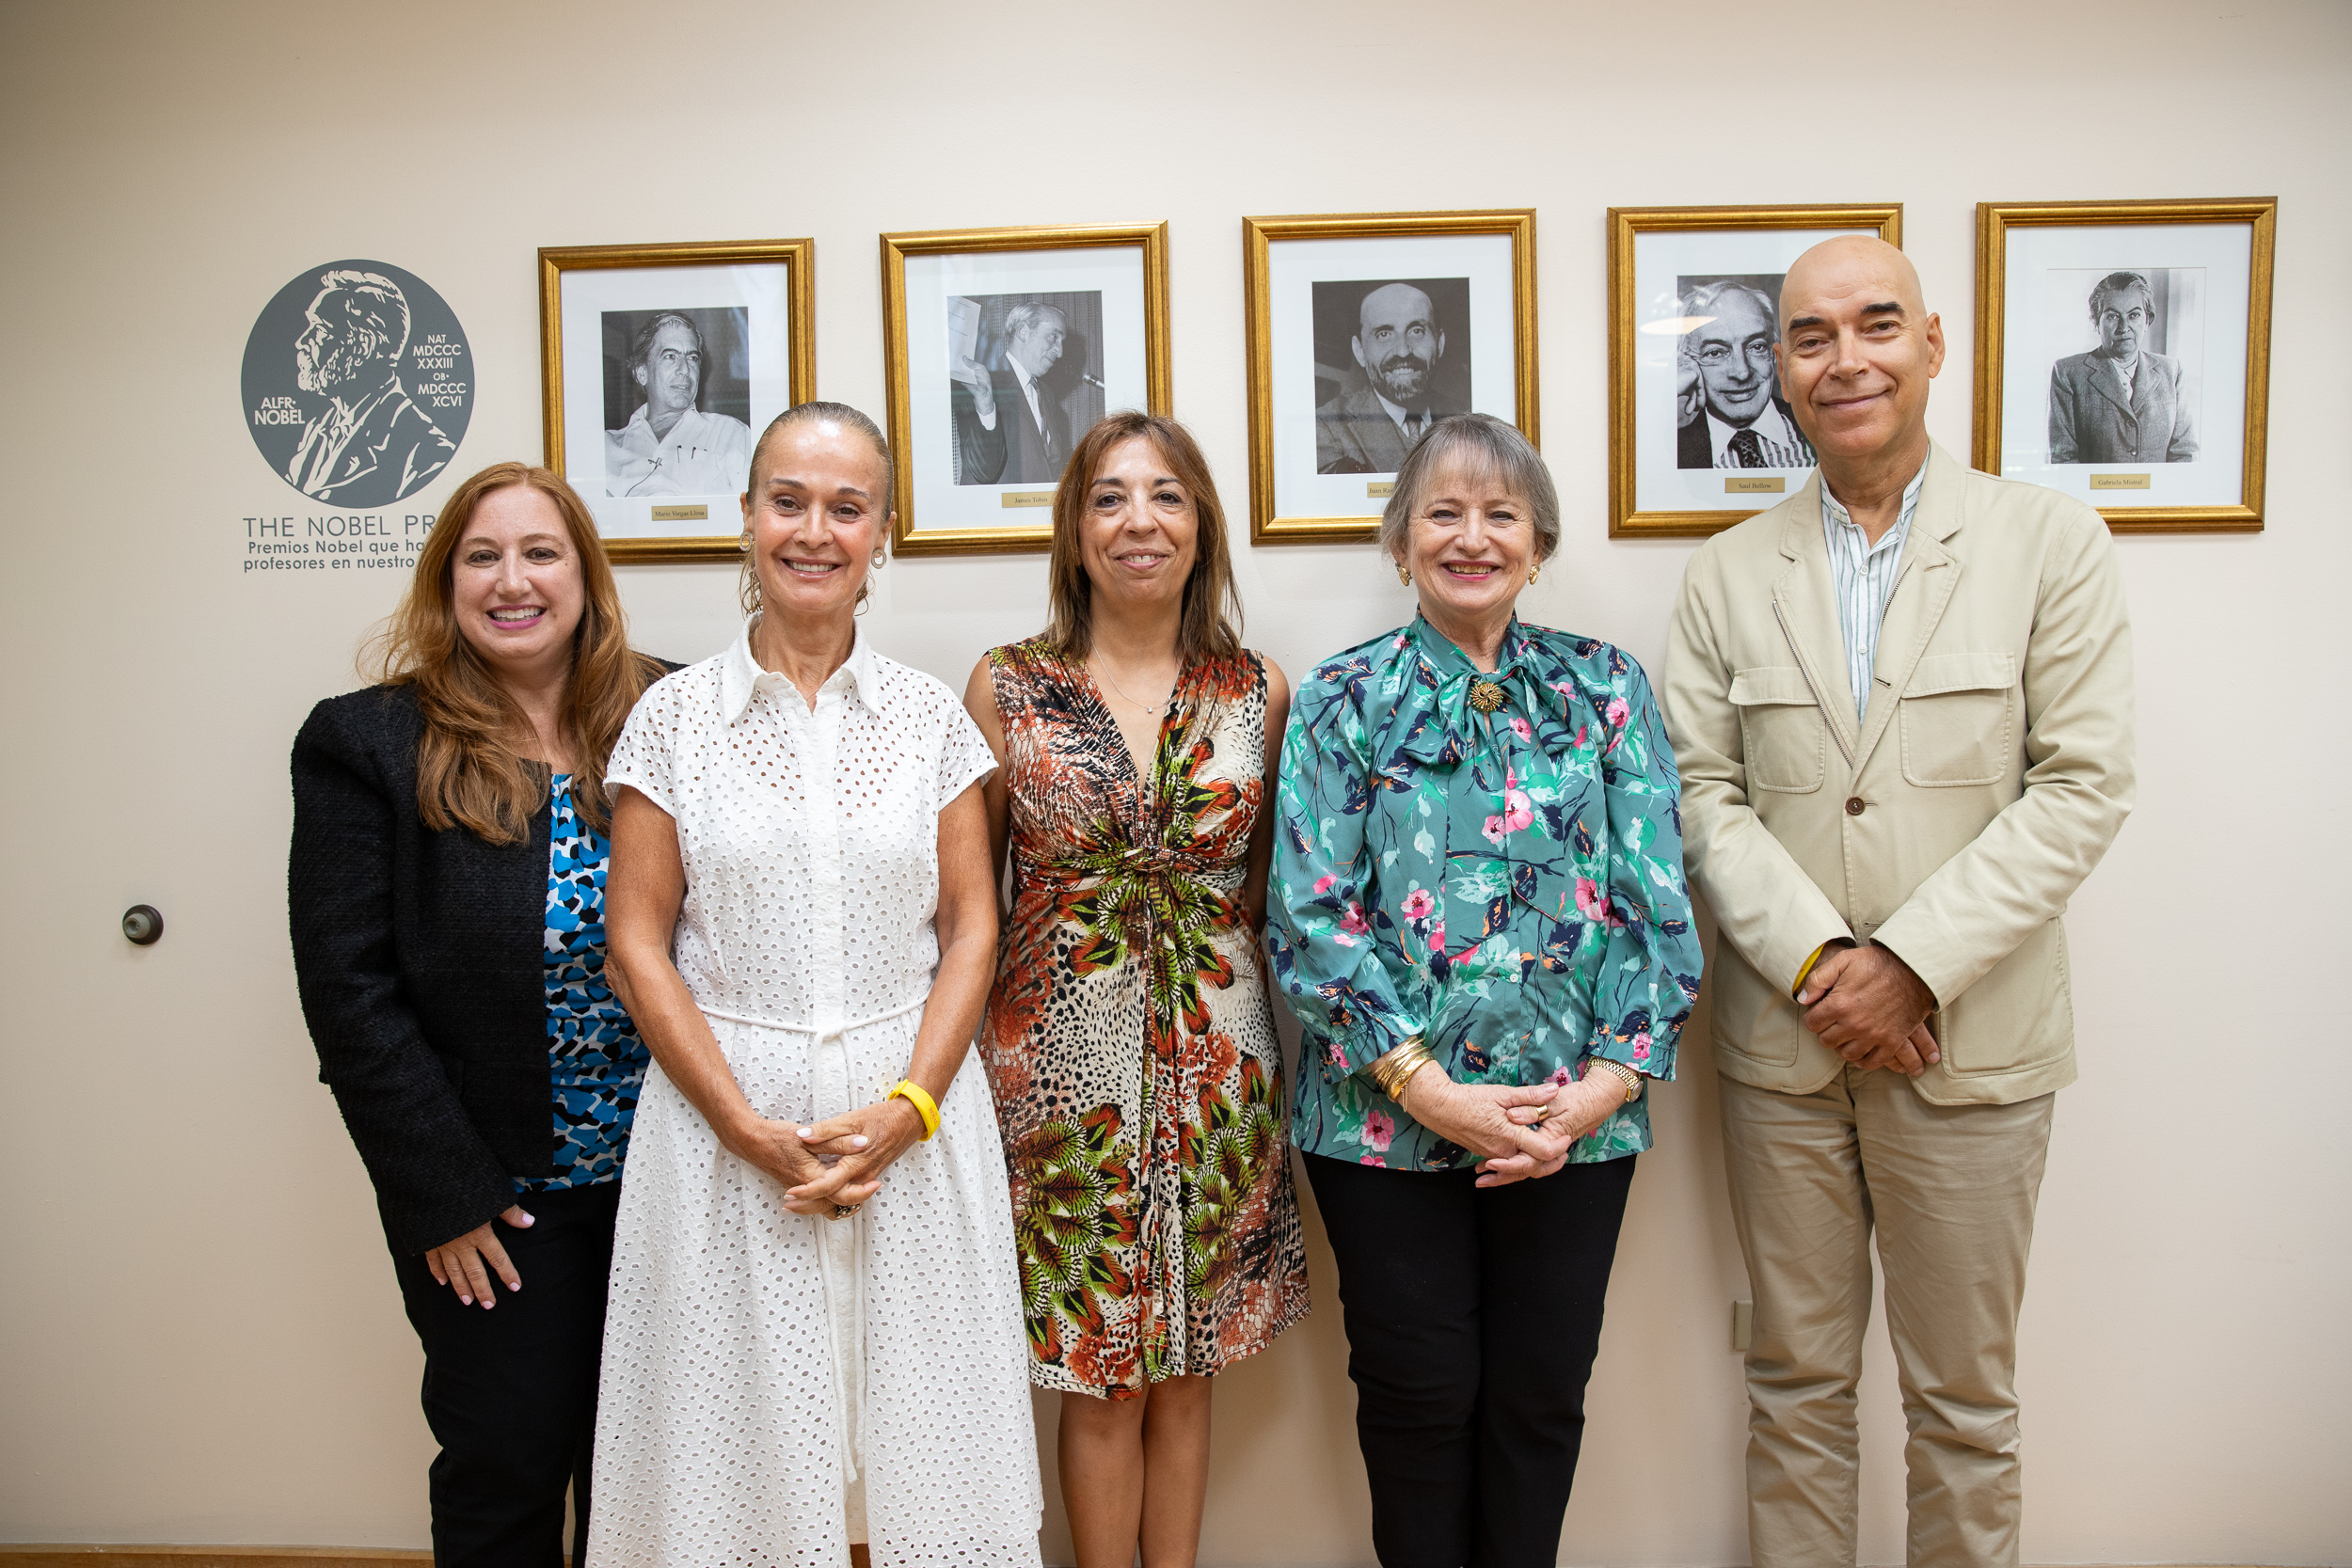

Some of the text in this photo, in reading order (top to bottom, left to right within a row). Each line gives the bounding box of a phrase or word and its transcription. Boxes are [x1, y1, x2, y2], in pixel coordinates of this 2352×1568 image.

[428, 334, 446, 344] NAT
[413, 344, 461, 356] MDCCC
[417, 357, 453, 369] XXXIII
[418, 382, 466, 395] MDCCC
[432, 396, 461, 407] XCVI
[254, 409, 305, 425] NOBEL
[243, 515, 437, 537] THE NOBEL PR
[248, 539, 425, 555] Premios Nobel que ha
[244, 555, 415, 573] profesores en nuestro
